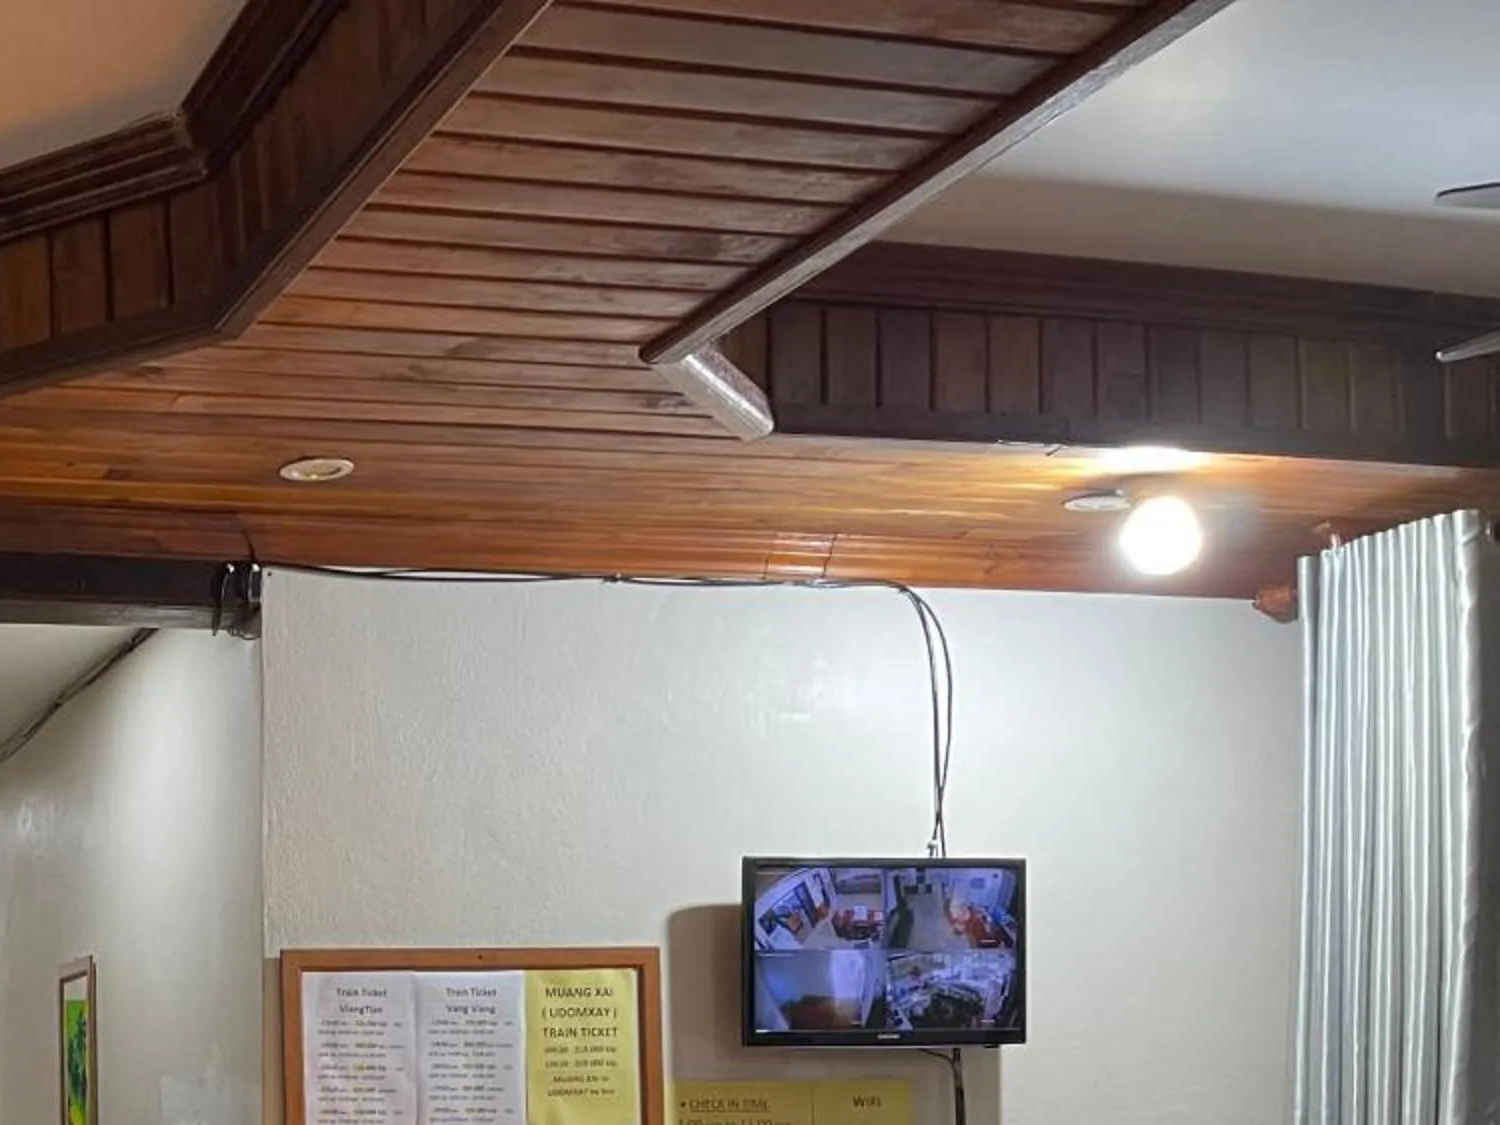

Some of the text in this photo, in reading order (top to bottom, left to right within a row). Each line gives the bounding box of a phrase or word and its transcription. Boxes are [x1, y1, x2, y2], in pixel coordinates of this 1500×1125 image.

[545, 986, 592, 998] MUANG
[543, 1026, 618, 1038] TRAIN TICKET
[690, 1099, 722, 1110] CHECK
[727, 1099, 740, 1109] IN
